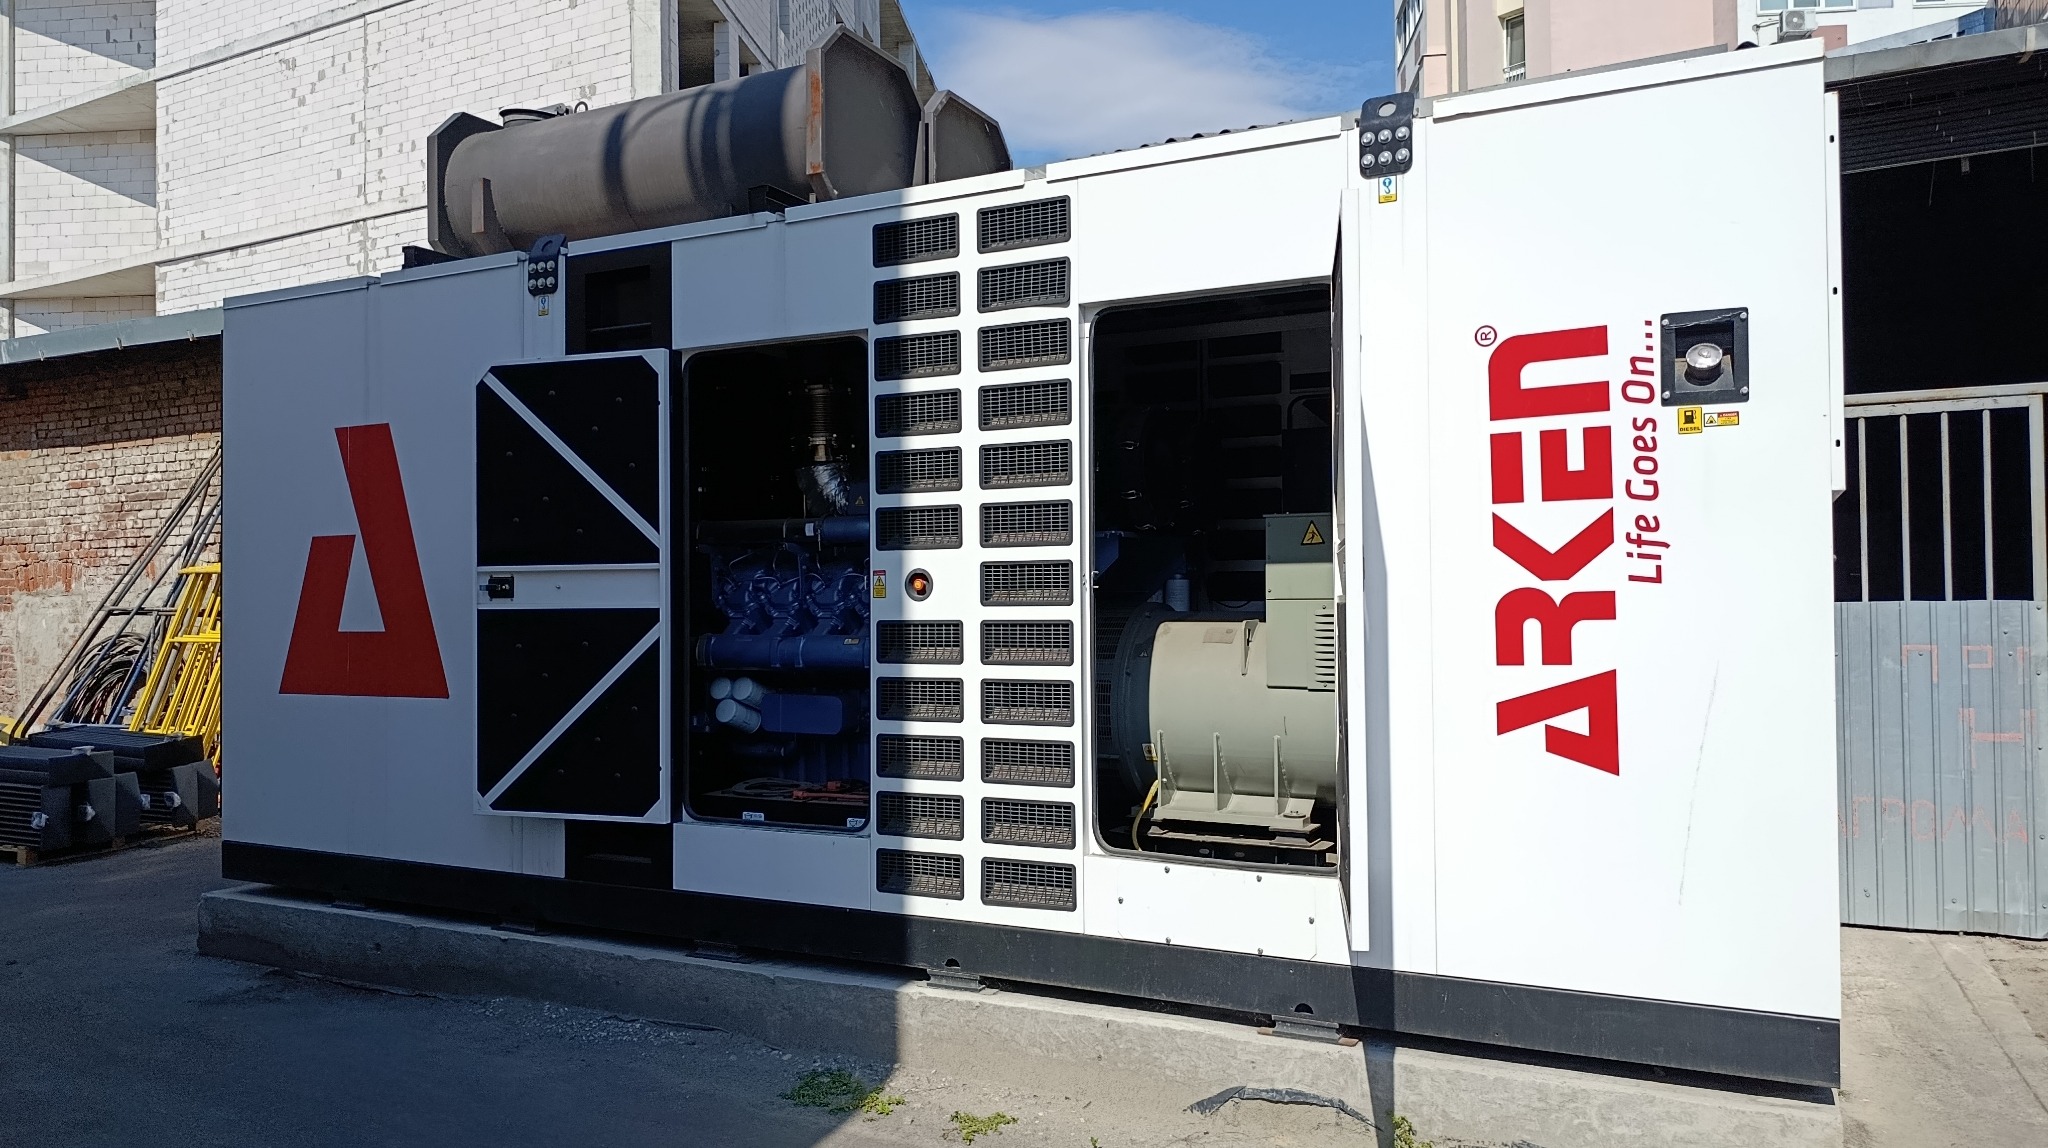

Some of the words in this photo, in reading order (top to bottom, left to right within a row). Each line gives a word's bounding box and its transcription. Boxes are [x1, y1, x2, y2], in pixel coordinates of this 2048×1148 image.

[1621, 320, 1655, 404] On...
[1625, 417, 1660, 502] Goes
[1488, 325, 1620, 777] ARKEN
[1625, 515, 1670, 584] Life
